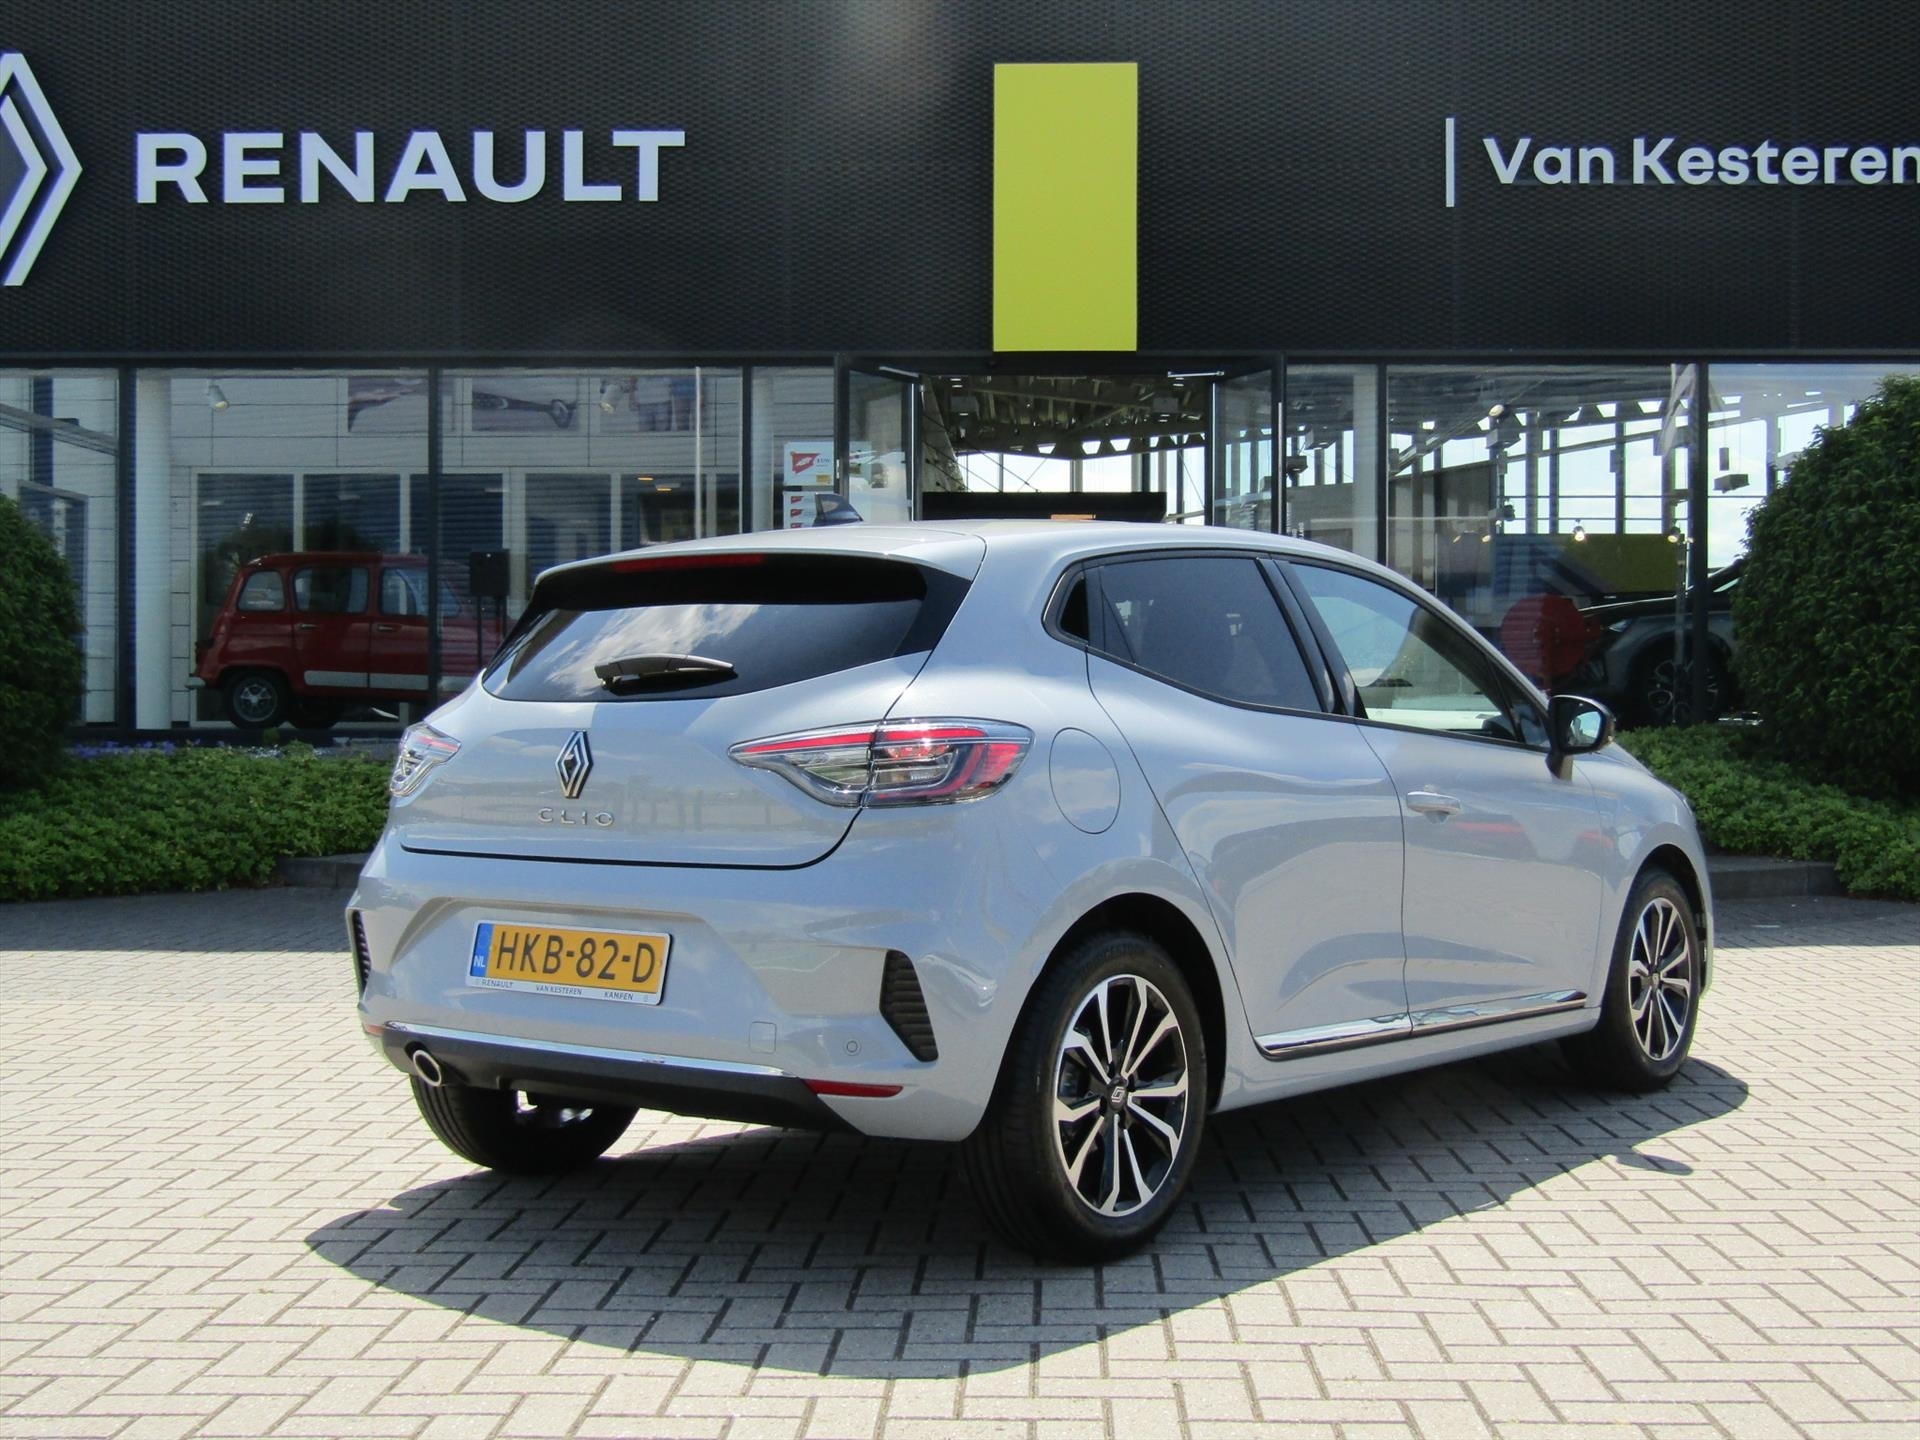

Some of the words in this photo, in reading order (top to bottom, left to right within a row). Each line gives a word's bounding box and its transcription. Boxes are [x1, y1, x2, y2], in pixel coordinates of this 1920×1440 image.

[135, 129, 685, 204] RENAULT
[1482, 136, 1614, 185] Van
[1633, 136, 1920, 185] Kesteren
[538, 807, 615, 827] CLIO
[473, 955, 486, 968] NL
[495, 930, 656, 983] HKB-82-D
[481, 979, 514, 989] RENAULT
[535, 984, 549, 993] VAN
[550, 986, 583, 996] KESTEREN
[604, 991, 634, 1001] KAMPEN
